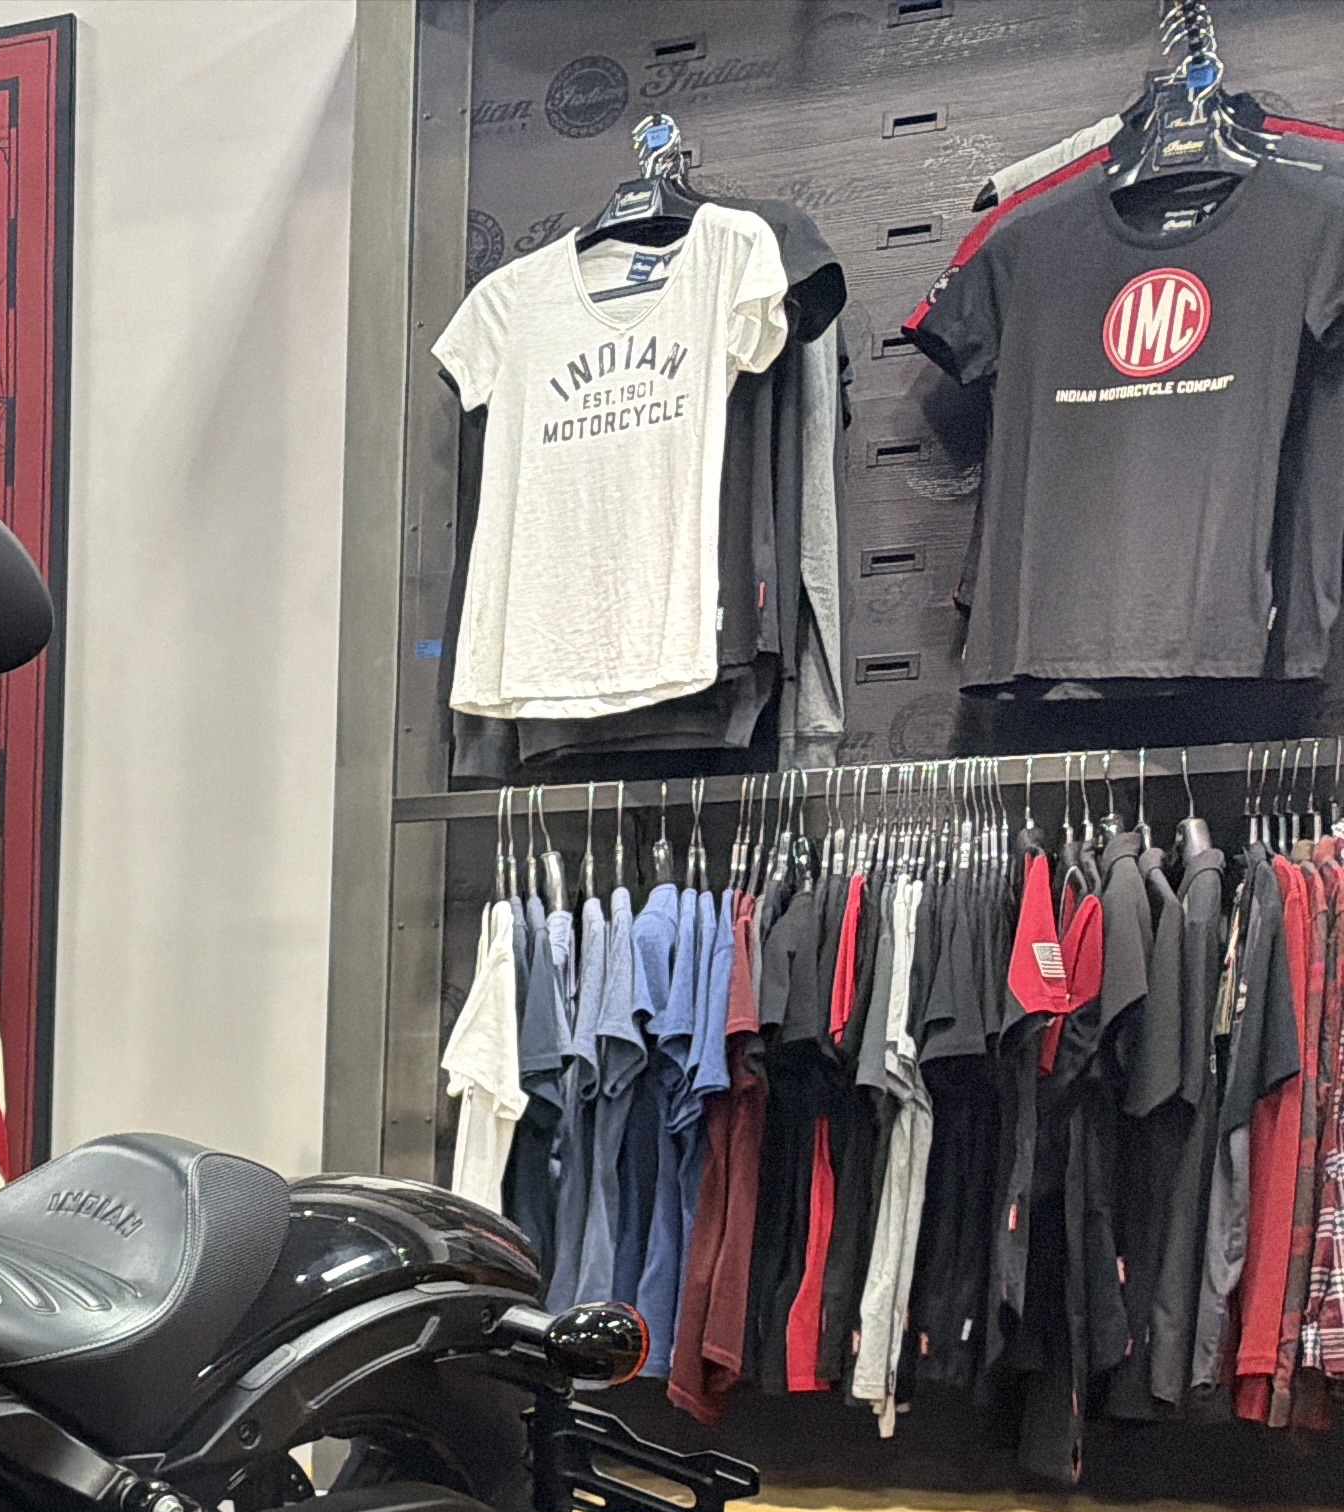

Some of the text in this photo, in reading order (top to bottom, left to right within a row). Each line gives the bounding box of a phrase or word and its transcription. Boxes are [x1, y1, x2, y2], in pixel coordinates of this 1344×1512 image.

[1117, 279, 1198, 365] IMC
[549, 335, 689, 403] INDIAN
[1056, 389, 1097, 403] INDIAN
[1099, 381, 1175, 402] MOTORCYCLE
[542, 393, 688, 445] MOTORCYCLE
[46, 1190, 144, 1239] INDIAN
